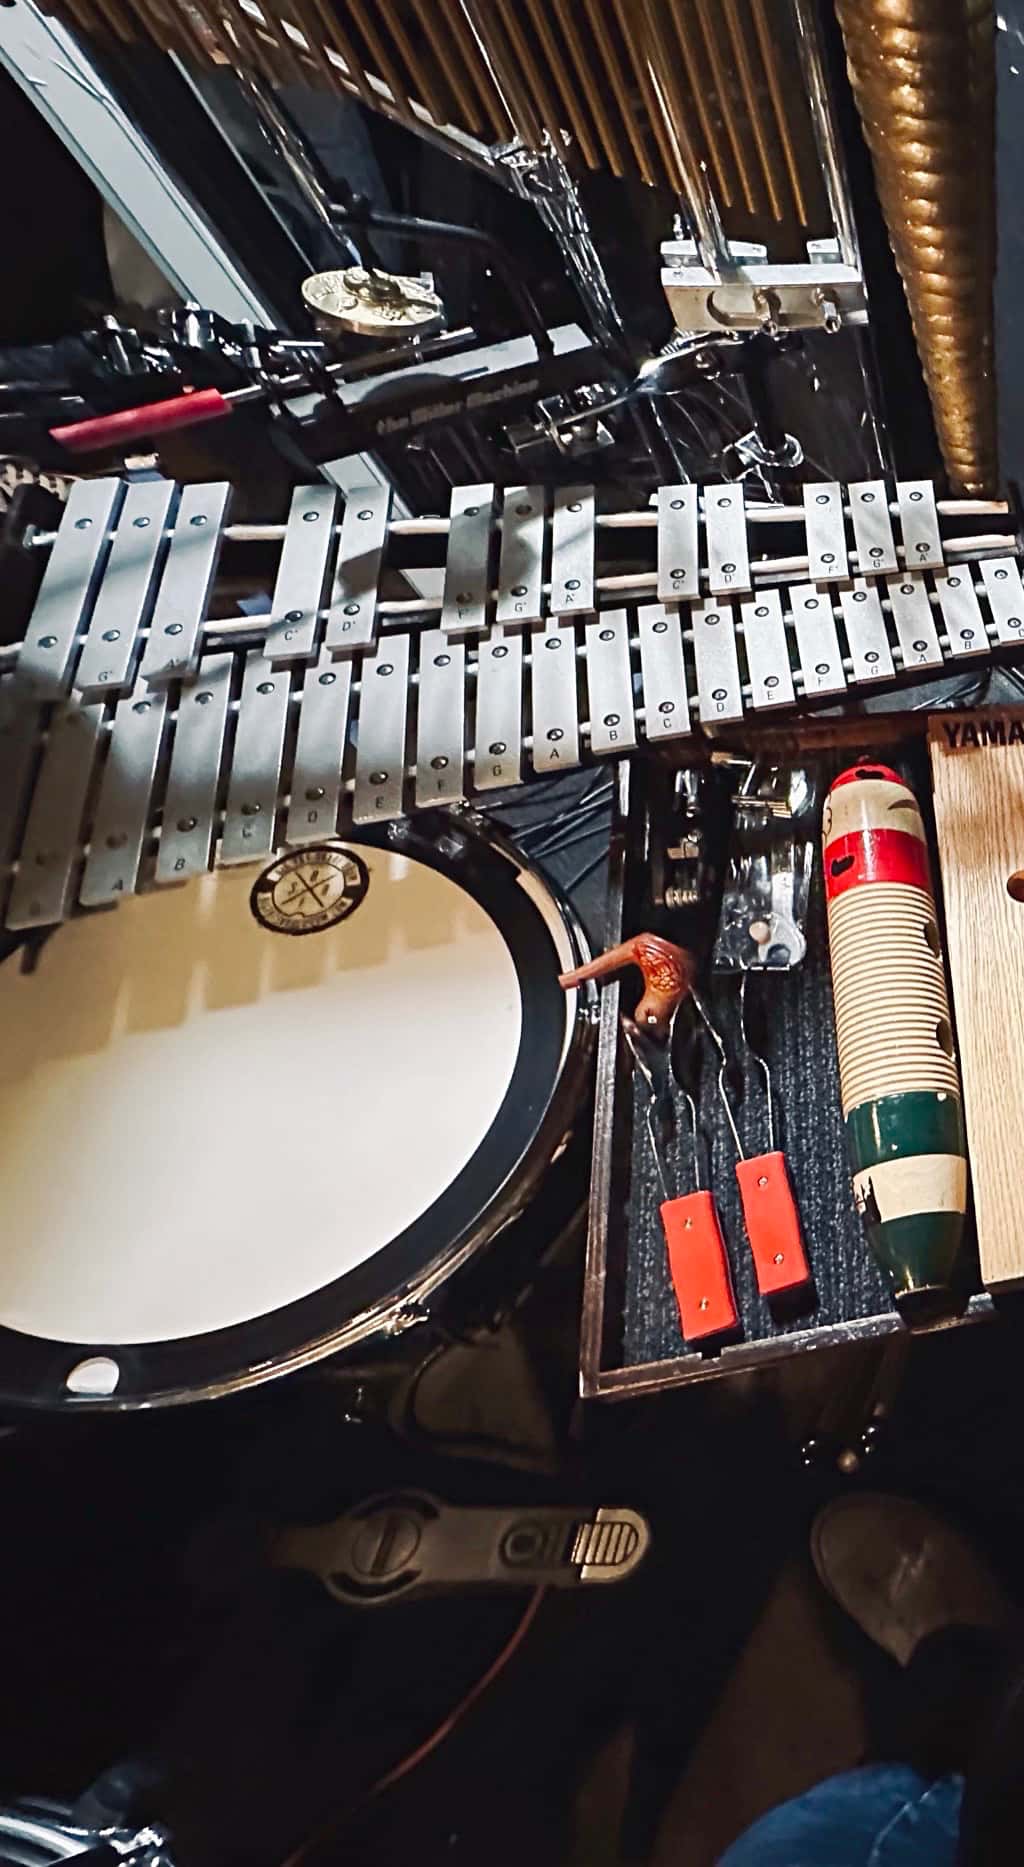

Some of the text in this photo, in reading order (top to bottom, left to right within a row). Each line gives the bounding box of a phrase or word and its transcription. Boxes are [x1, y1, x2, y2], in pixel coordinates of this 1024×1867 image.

[918, 653, 927, 663] A
[767, 690, 775, 700] E
[716, 702, 725, 712] D
[663, 718, 672, 729] C
[609, 730, 618, 741] B
[549, 749, 560, 759] A
[174, 858, 186, 871] B
